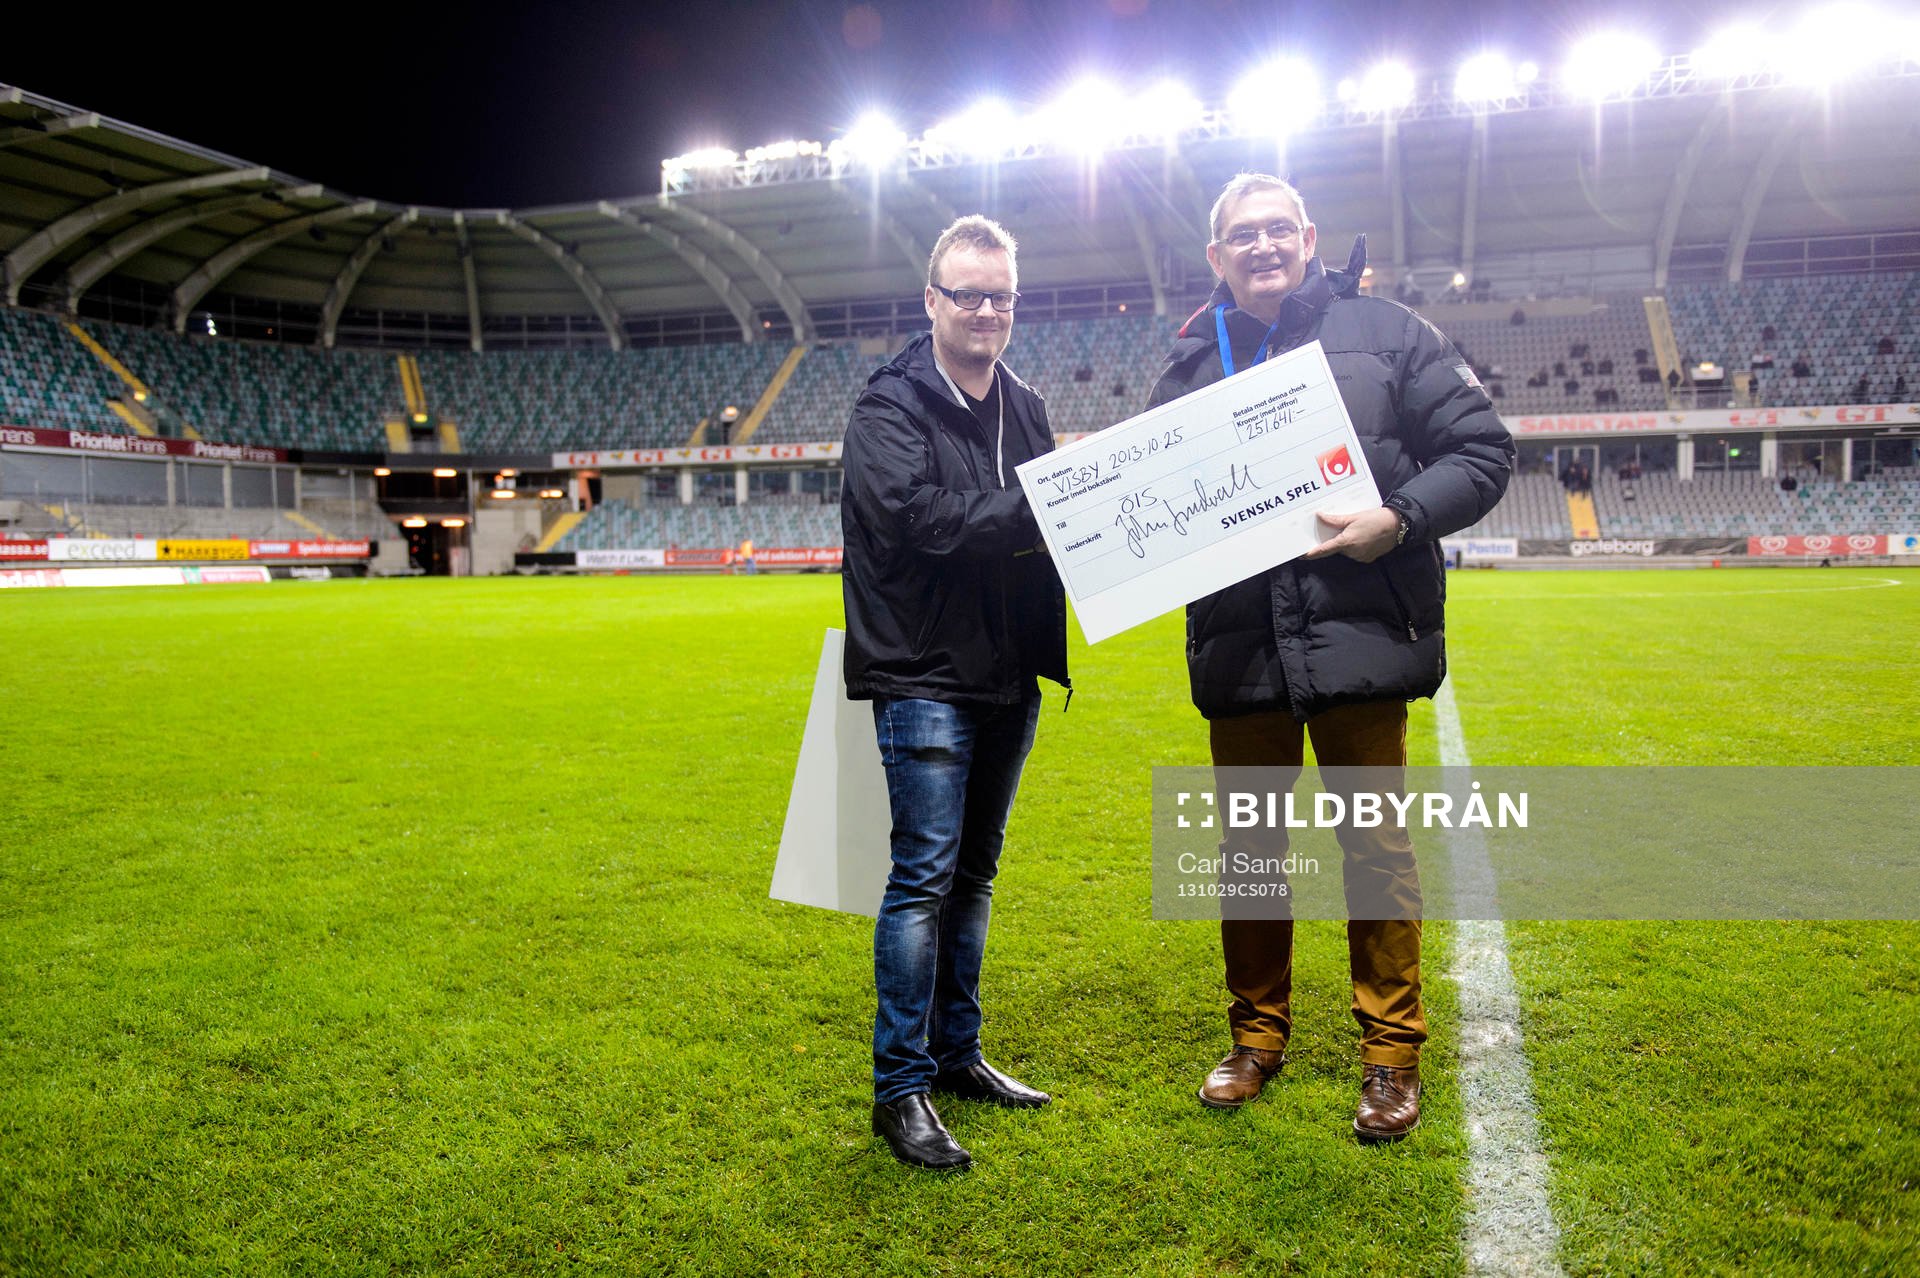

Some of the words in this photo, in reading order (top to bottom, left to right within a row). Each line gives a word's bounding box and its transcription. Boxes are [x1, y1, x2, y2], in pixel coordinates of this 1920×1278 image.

[1232, 406, 1254, 418] Betala
[1254, 400, 1268, 410] mot
[1268, 392, 1288, 404] denna
[1288, 383, 1307, 395] check
[1236, 414, 1259, 428] Kronor
[1259, 406, 1276, 418] (med
[1277, 397, 1298, 411] siffror)
[1835, 405, 1894, 423] GT
[1037, 475, 1051, 486] Ort,
[1051, 466, 1073, 480] datum
[1046, 495, 1070, 509] Kronor
[1070, 487, 1088, 500] (med
[1088, 472, 1122, 491] bokstäver)
[1053, 461, 1099, 495] VISBY
[1221, 494, 1285, 530] SVENSKA
[1286, 480, 1320, 502] SPEL
[1056, 521, 1068, 531] Till
[1064, 533, 1103, 553] Underskrift
